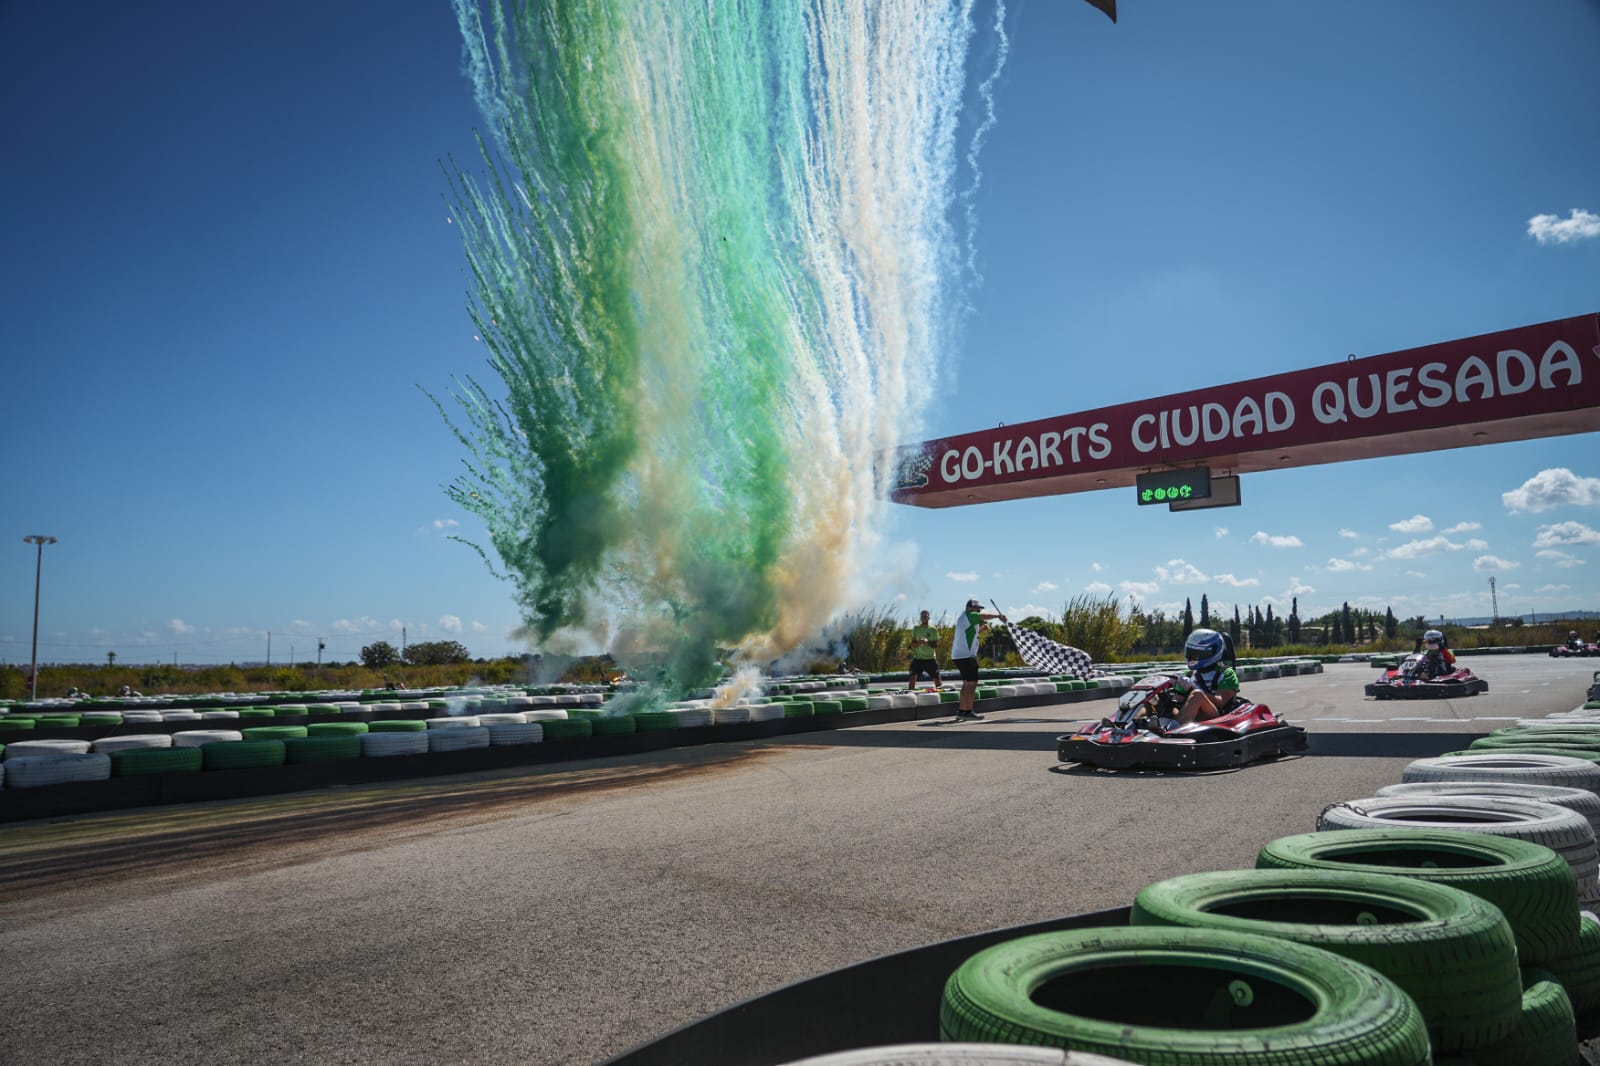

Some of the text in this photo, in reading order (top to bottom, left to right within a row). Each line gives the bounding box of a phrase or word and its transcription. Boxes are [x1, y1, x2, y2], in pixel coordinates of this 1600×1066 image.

[941, 340, 1583, 483] GO-KARTS CIUDAD QUESADA
